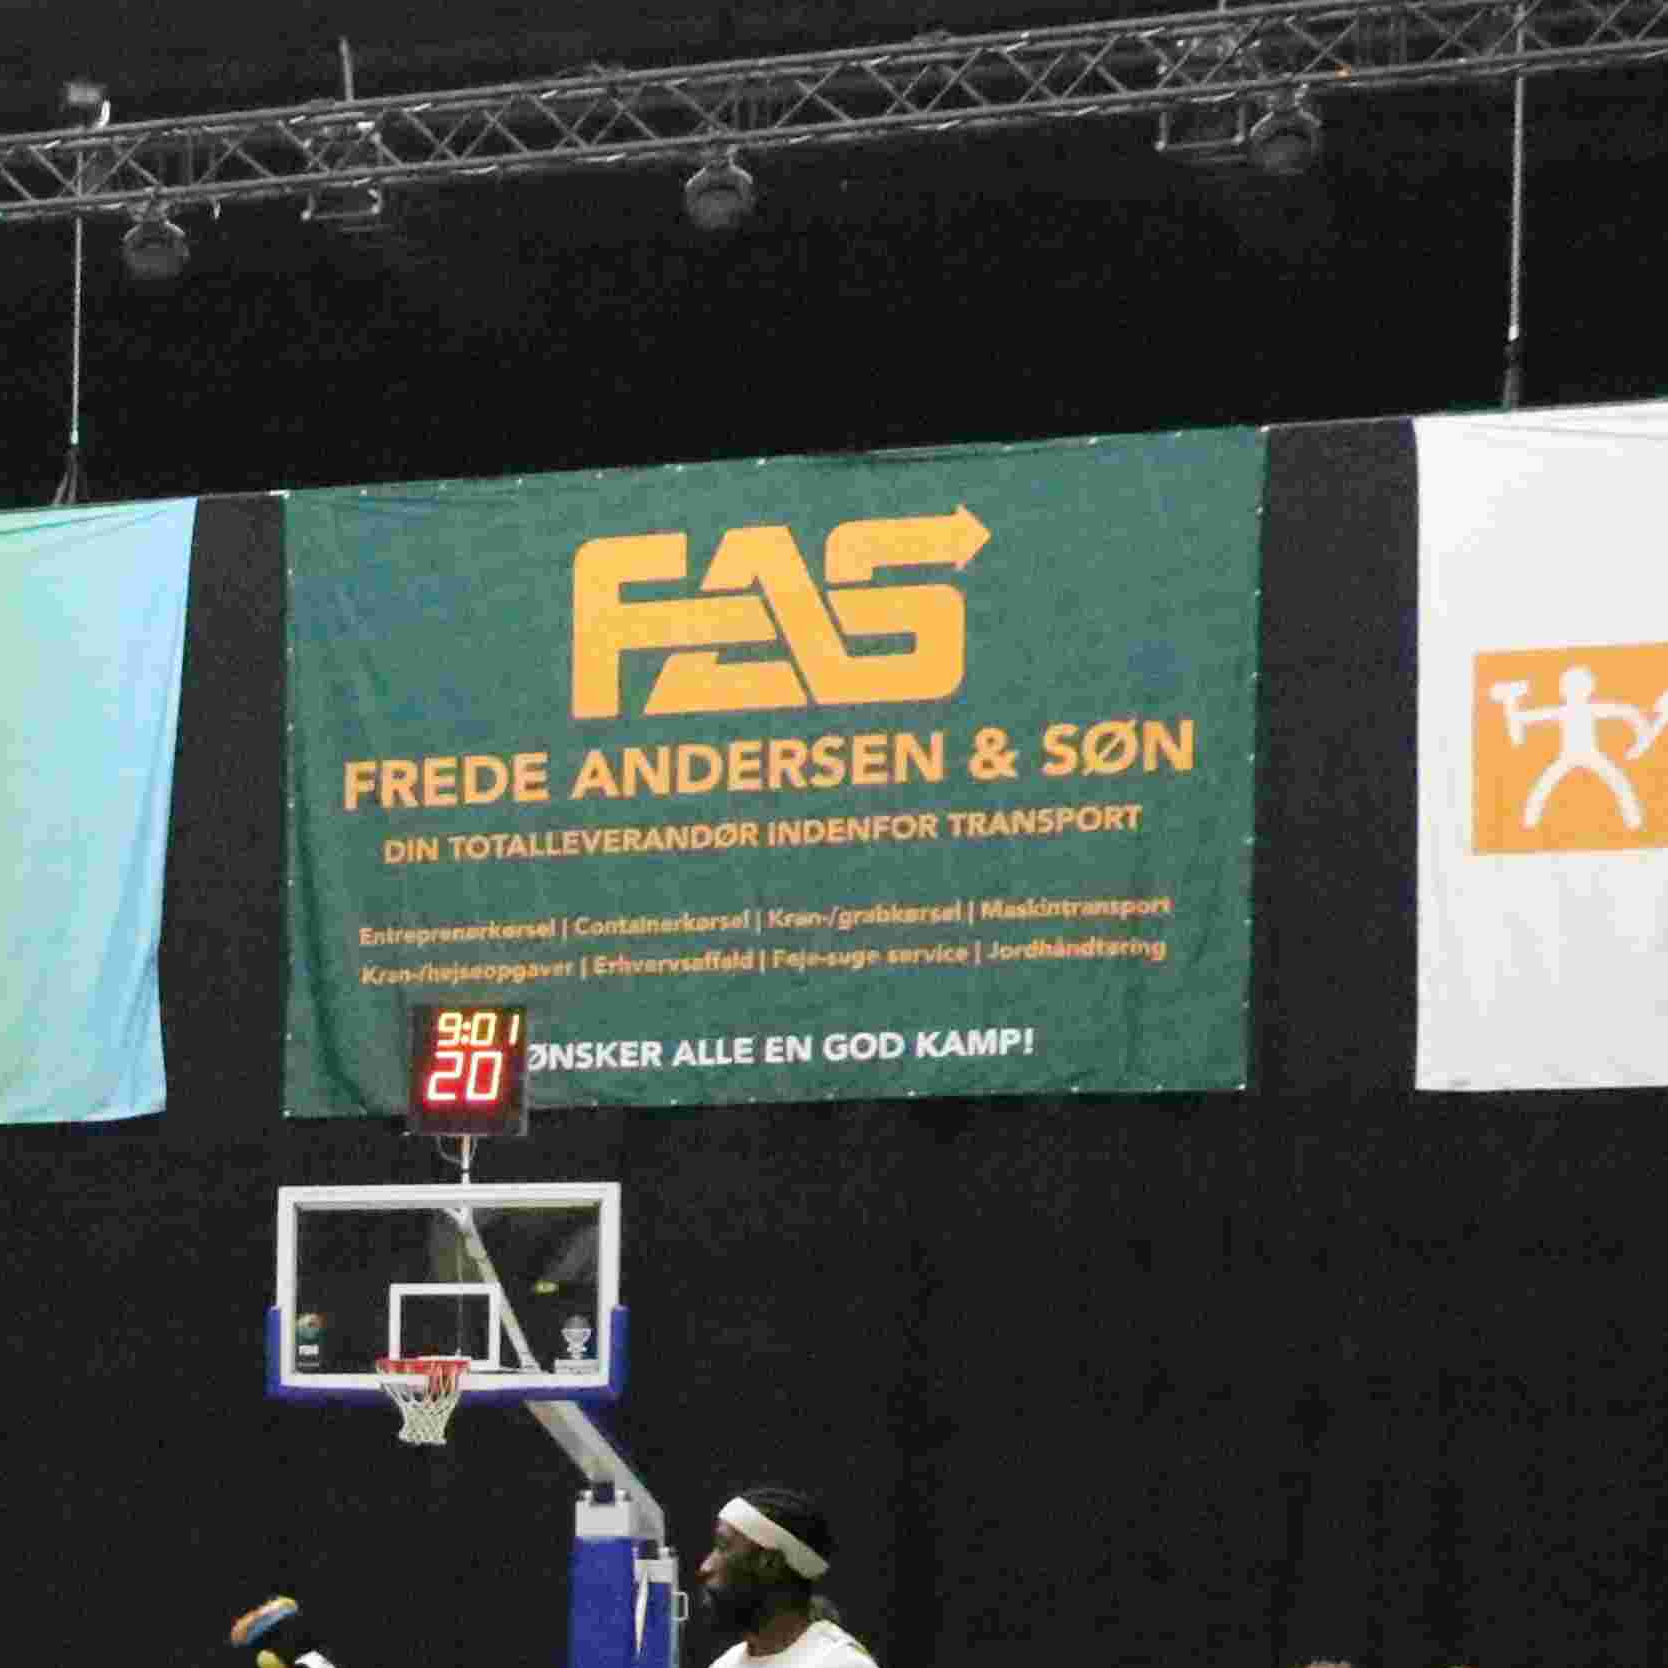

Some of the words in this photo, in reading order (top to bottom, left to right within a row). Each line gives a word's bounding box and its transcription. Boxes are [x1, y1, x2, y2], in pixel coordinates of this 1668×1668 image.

[572, 503, 992, 719] FAS
[344, 752, 548, 810] FREDE
[572, 729, 945, 801] ANDERSEN
[969, 726, 1019, 783] &
[1041, 719, 1196, 777] SØN
[383, 835, 439, 864] DIN
[448, 820, 759, 861] TOTALLEVERANDØR
[768, 812, 939, 849] INDENFOR
[948, 804, 1143, 841] TRANSPORT
[981, 896, 1175, 923] Maskintransport
[436, 1011, 521, 1048] 9:01
[529, 1041, 662, 1074] ØNSKER
[671, 1037, 754, 1067] ALLE
[764, 1036, 813, 1065] EN
[822, 1032, 905, 1063] GOD
[915, 1028, 1036, 1058] KAMP!
[425, 1049, 504, 1103] 20
